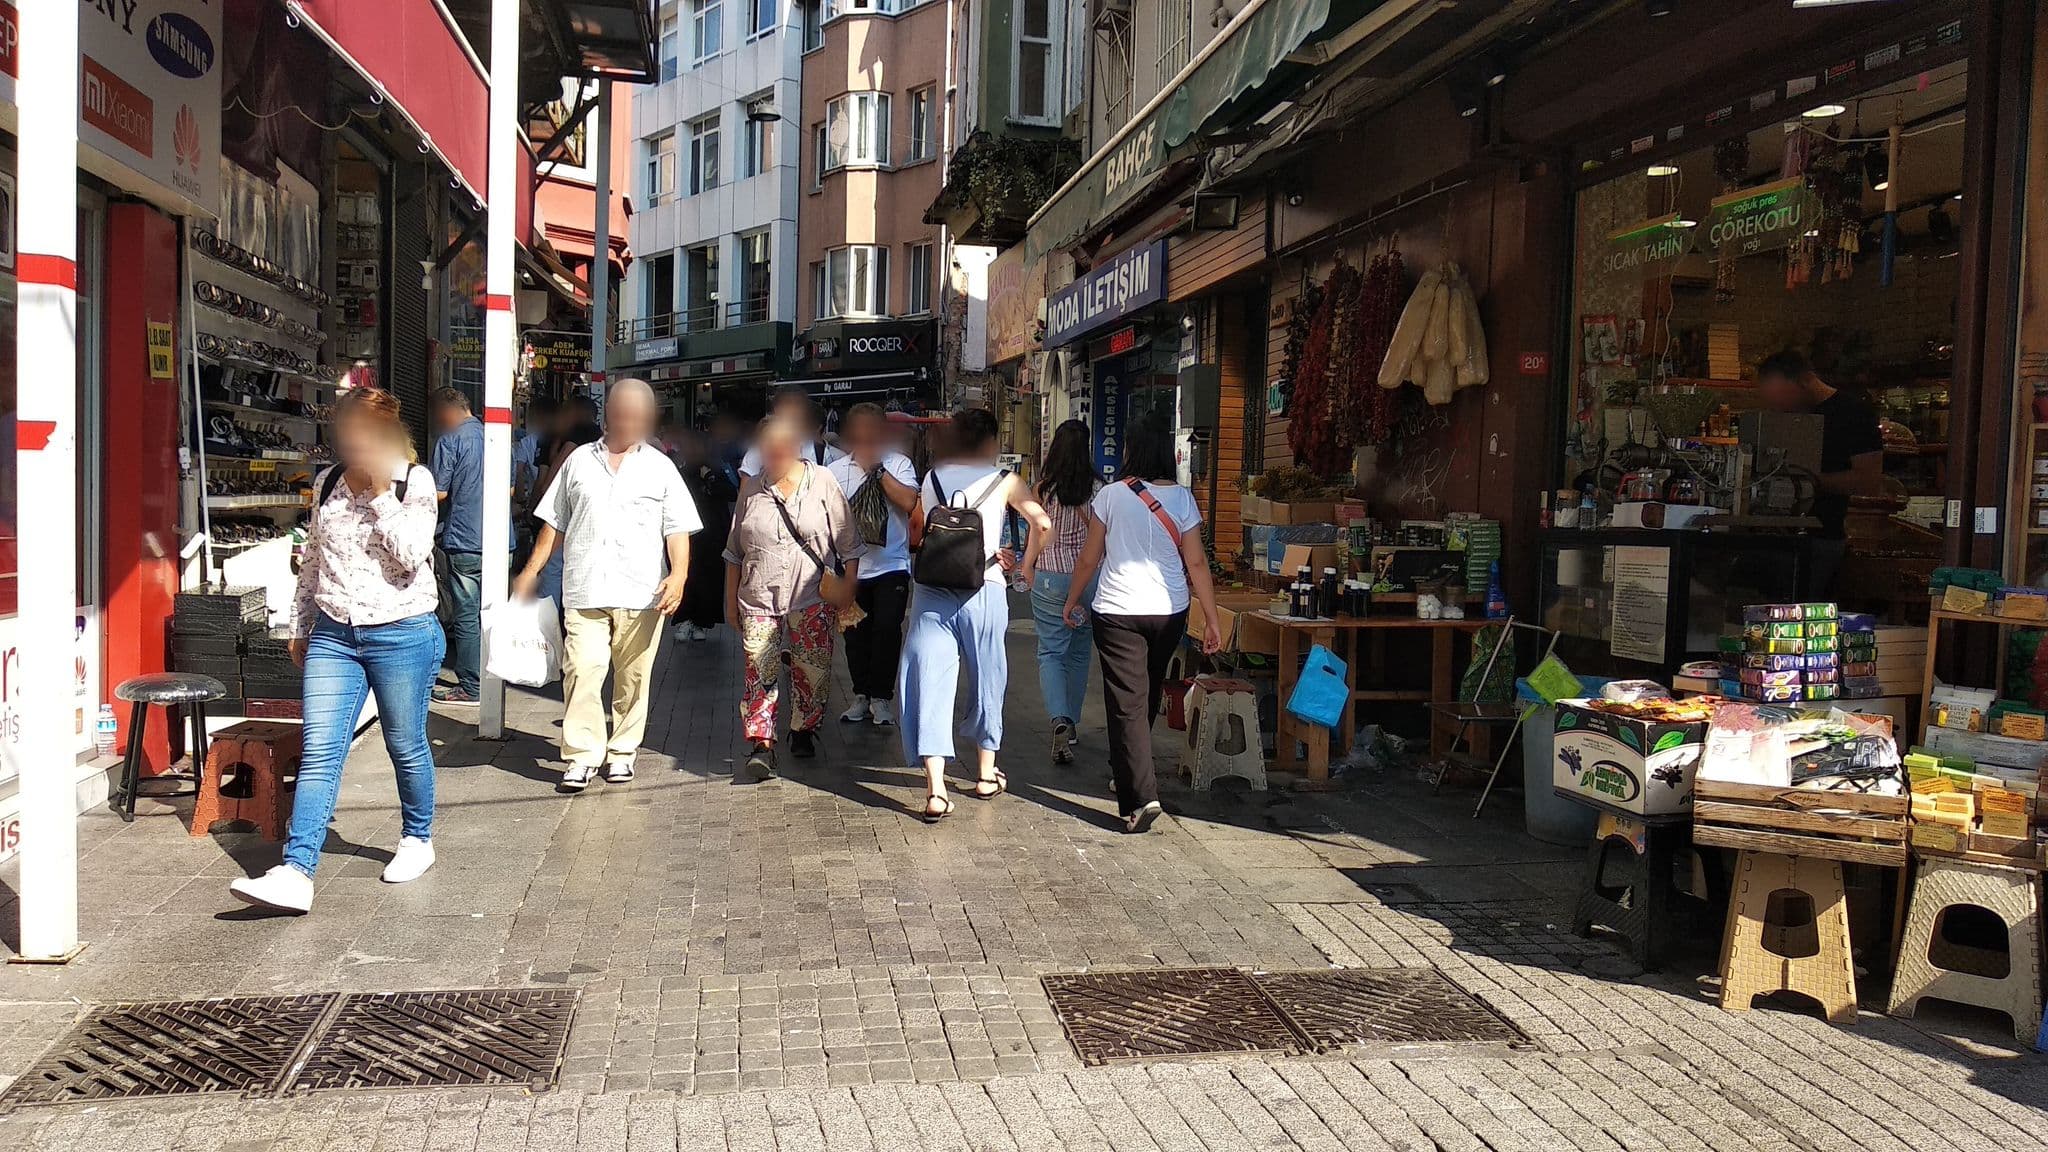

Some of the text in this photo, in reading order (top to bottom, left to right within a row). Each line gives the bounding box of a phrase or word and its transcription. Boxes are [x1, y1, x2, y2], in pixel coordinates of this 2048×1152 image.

[154, 15, 208, 74] SAMSUNG
[107, 85, 150, 139] Xiaomi
[1105, 118, 1157, 197] BAHÇE
[172, 170, 200, 196] HUAWEI
[1732, 194, 1778, 215] soğuk pres
[1709, 205, 1800, 249] ÇÖREKOTU
[1603, 234, 1684, 273] SICAK TAHİN
[1047, 291, 1080, 338] MODA
[1083, 250, 1150, 322] İLETİŞİM
[534, 346, 559, 356] ERKEK
[553, 341, 575, 349] ADEM
[833, 382, 852, 391] GARAJ
[1103, 375, 1119, 456] AKSESUAR
